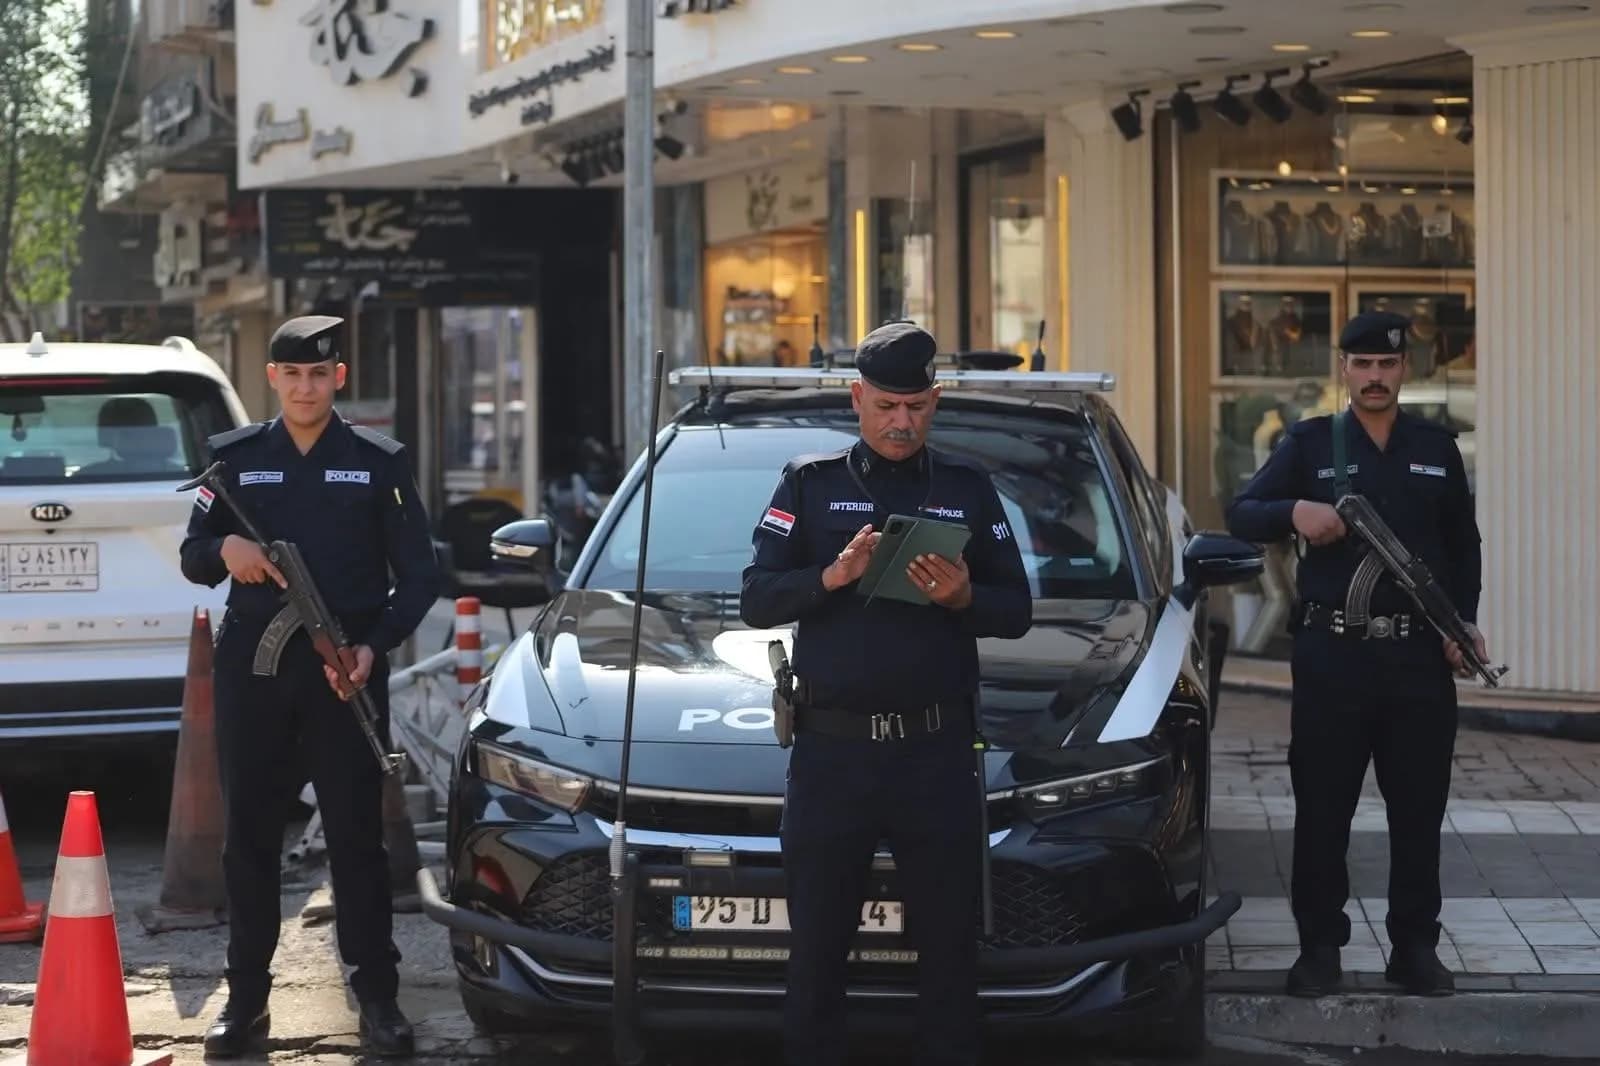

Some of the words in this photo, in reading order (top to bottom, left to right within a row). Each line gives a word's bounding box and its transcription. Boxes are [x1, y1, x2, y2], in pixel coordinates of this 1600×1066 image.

[35, 505, 67, 519] KIA
[829, 502, 874, 513] INTERIOR
[942, 508, 965, 518] POLICE
[992, 522, 1010, 540] 911
